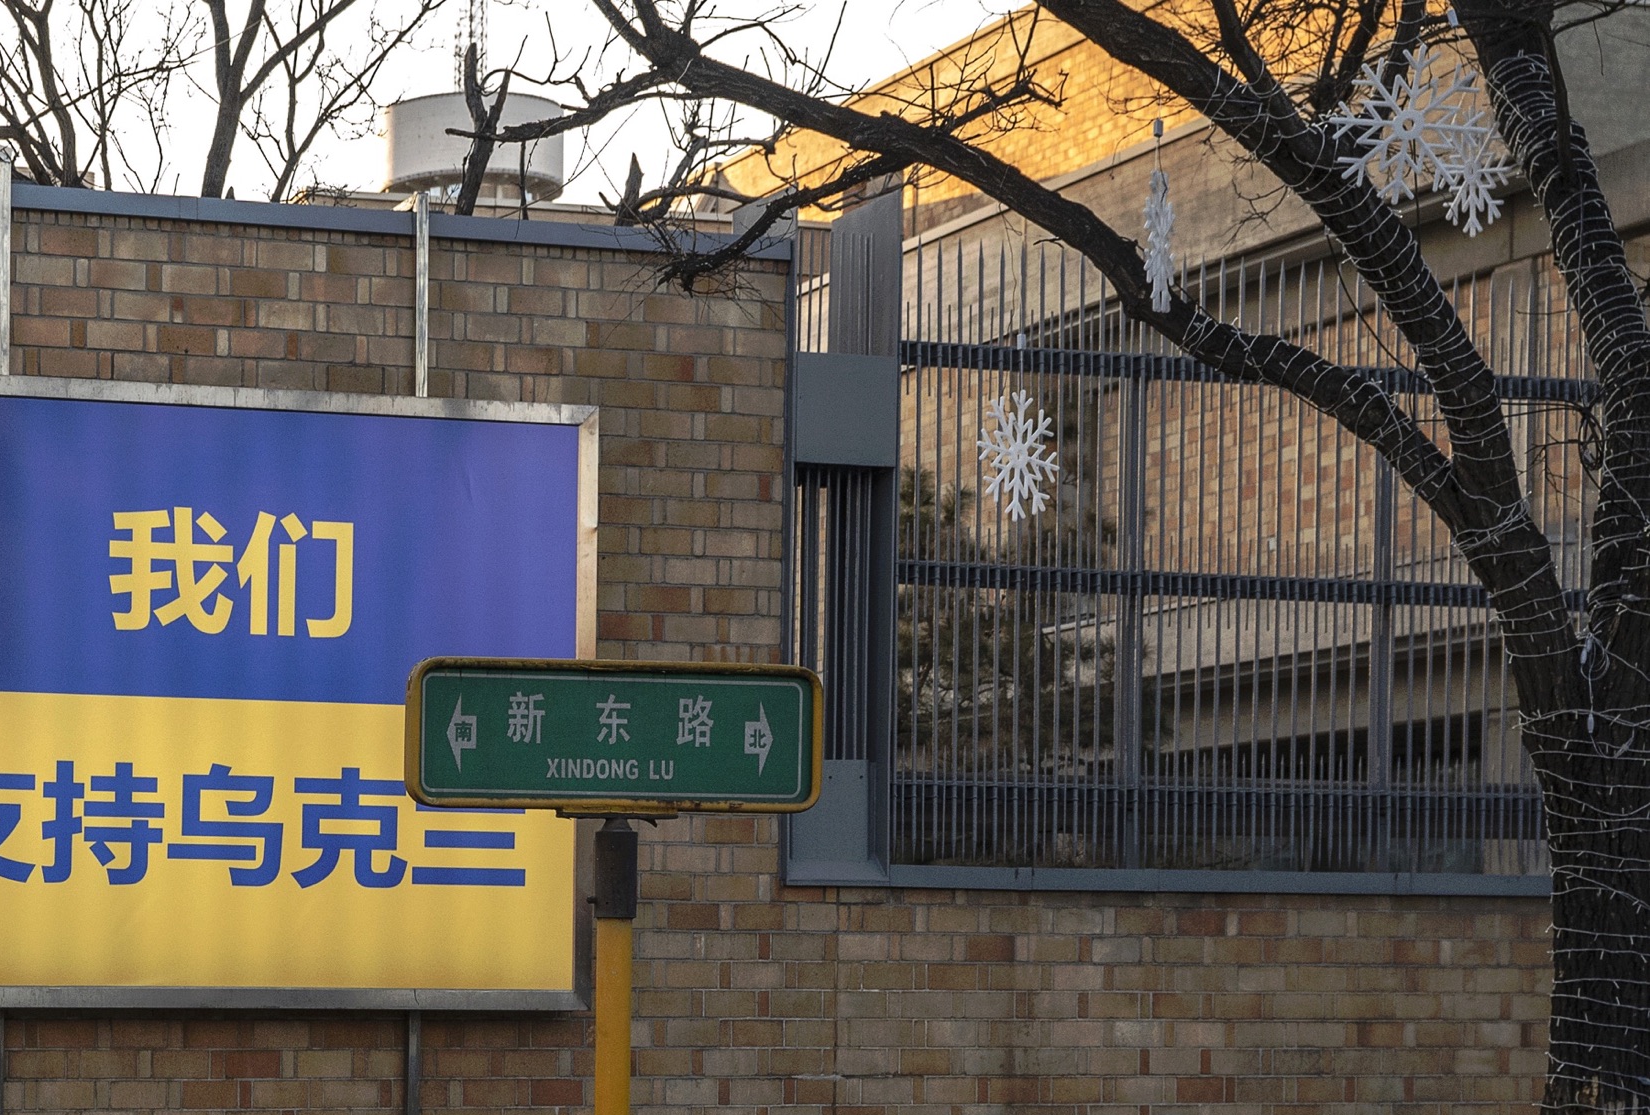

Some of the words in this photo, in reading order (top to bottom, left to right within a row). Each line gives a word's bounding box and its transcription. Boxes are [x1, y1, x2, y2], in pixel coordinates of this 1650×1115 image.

[108, 506, 354, 638] 我们
[507, 691, 714, 748] 新东路
[454, 720, 473, 743] 南
[748, 728, 767, 749] 北
[545, 757, 640, 780] XINDONG
[649, 759, 675, 780] LU
